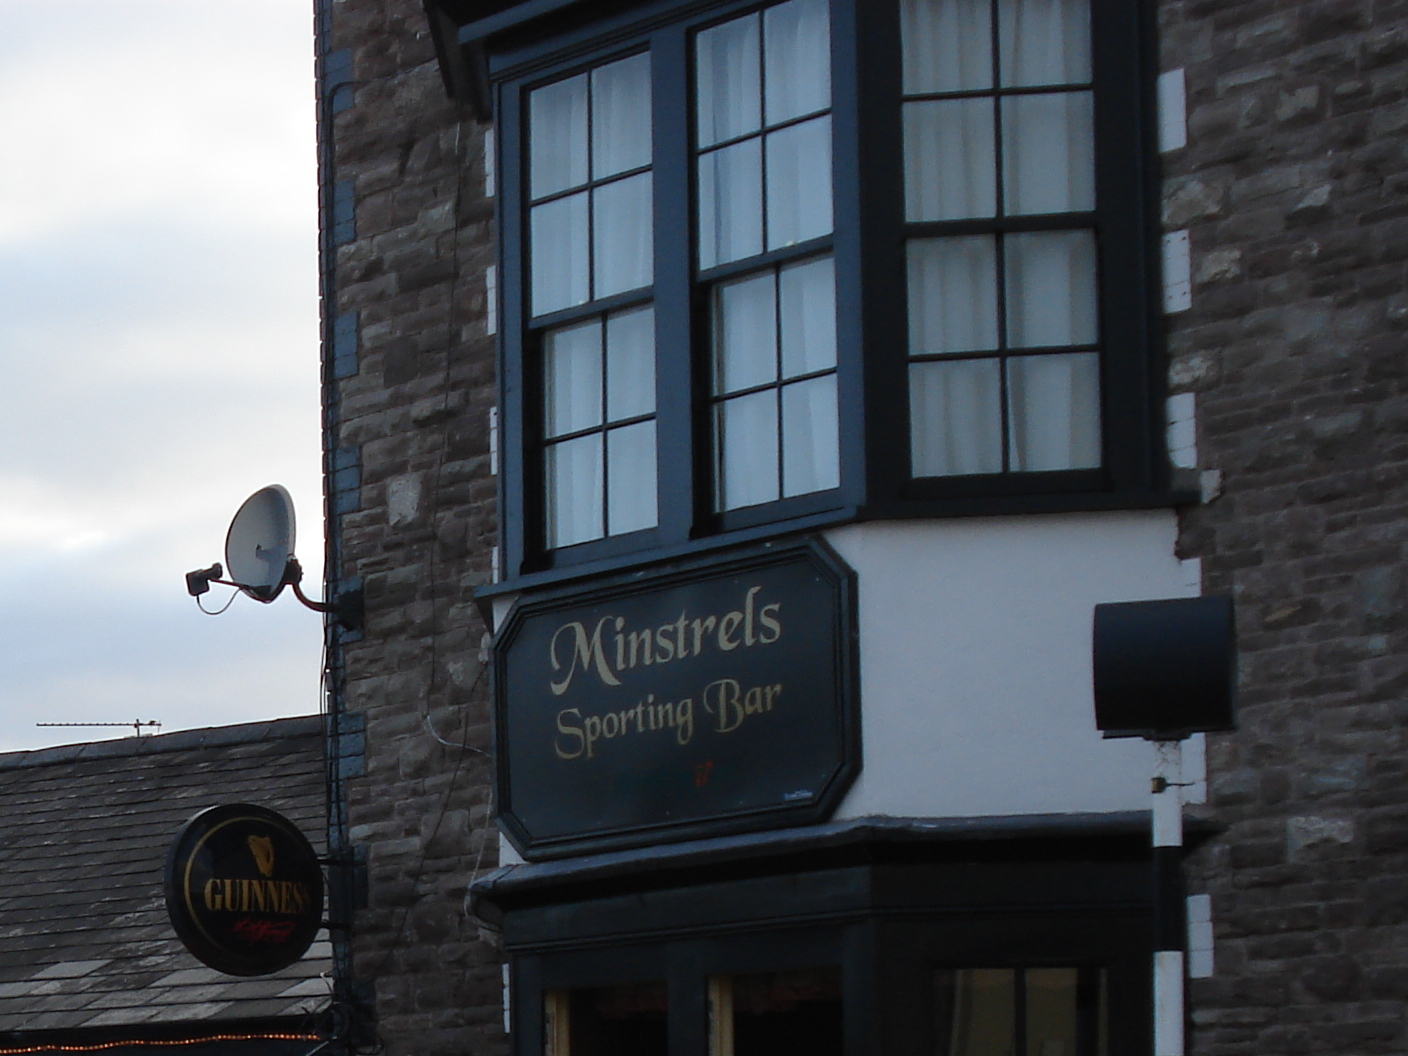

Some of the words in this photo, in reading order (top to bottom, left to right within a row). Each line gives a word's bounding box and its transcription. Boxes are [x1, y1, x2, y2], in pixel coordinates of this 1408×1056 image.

[550, 586, 783, 696] Minstrels
[555, 693, 693, 760] Sporting
[704, 678, 783, 733] Bar
